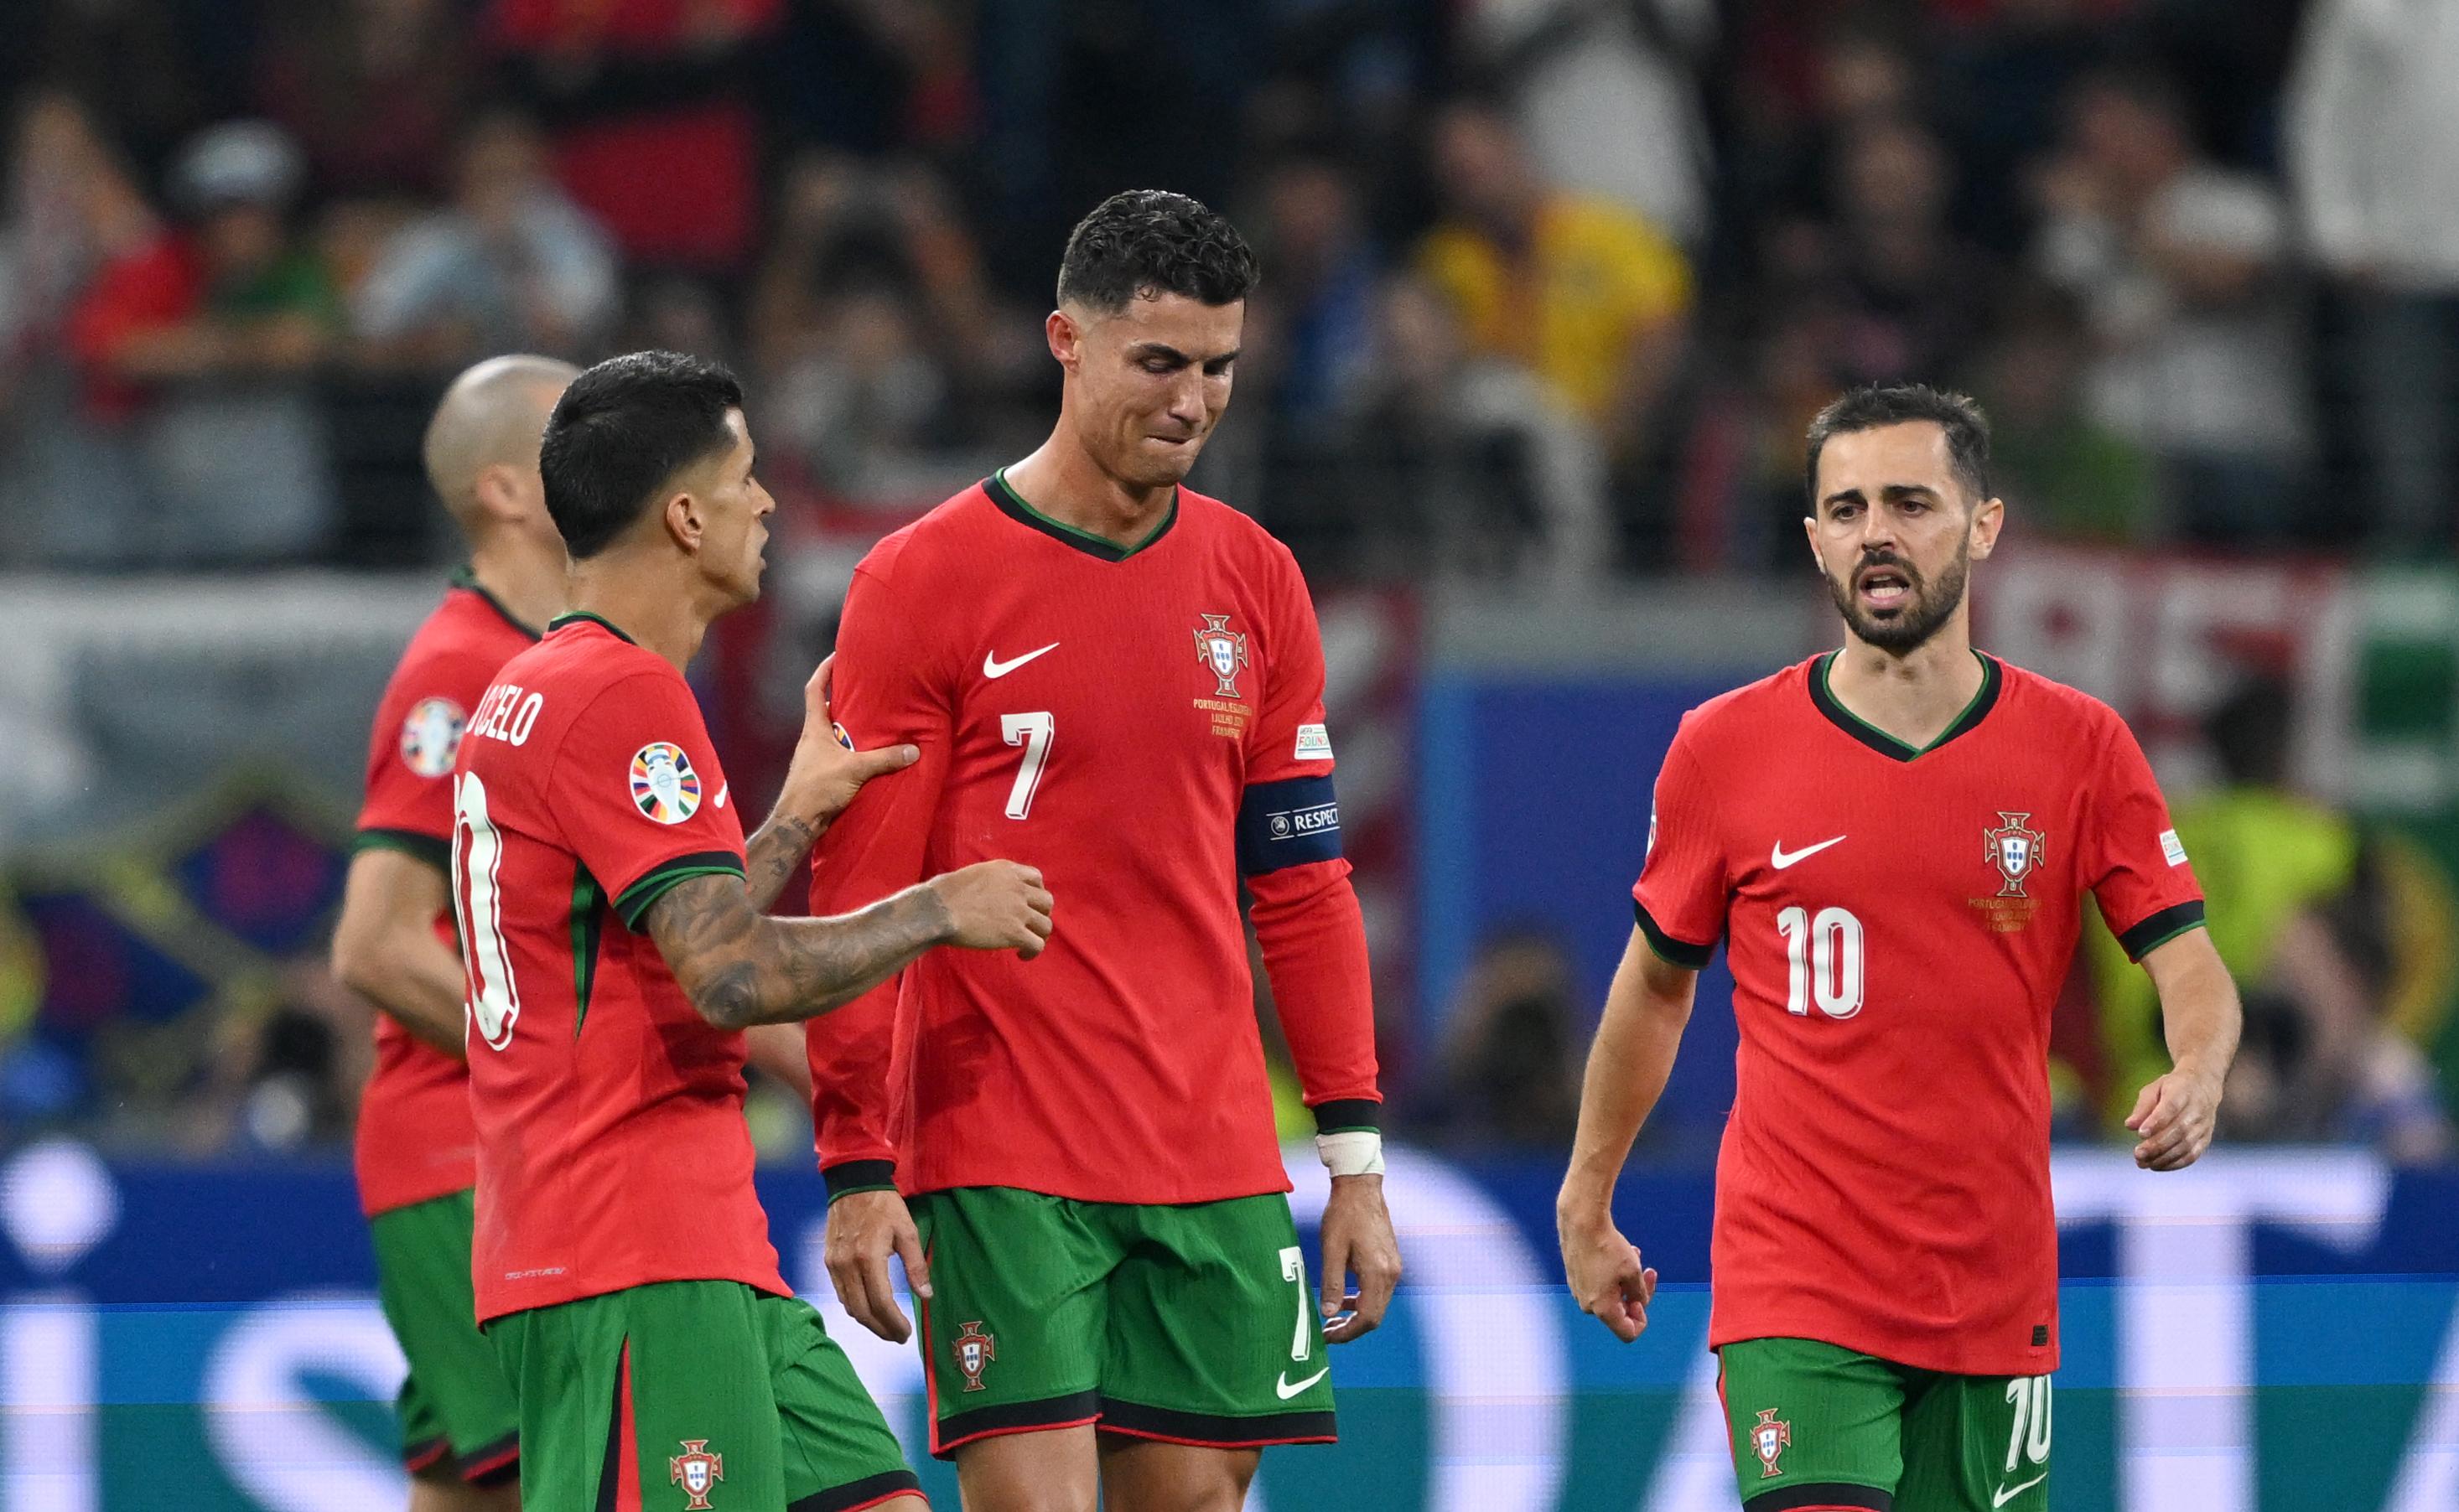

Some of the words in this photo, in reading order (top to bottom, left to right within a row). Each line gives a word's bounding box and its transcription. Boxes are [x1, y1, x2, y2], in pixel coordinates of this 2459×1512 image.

[1000, 711, 1055, 821] 7
[1294, 808, 1339, 831] RESPECT
[1777, 906, 1865, 1019] 10
[1279, 1246, 1311, 1362] 7
[2005, 1374, 2052, 1473] 10
